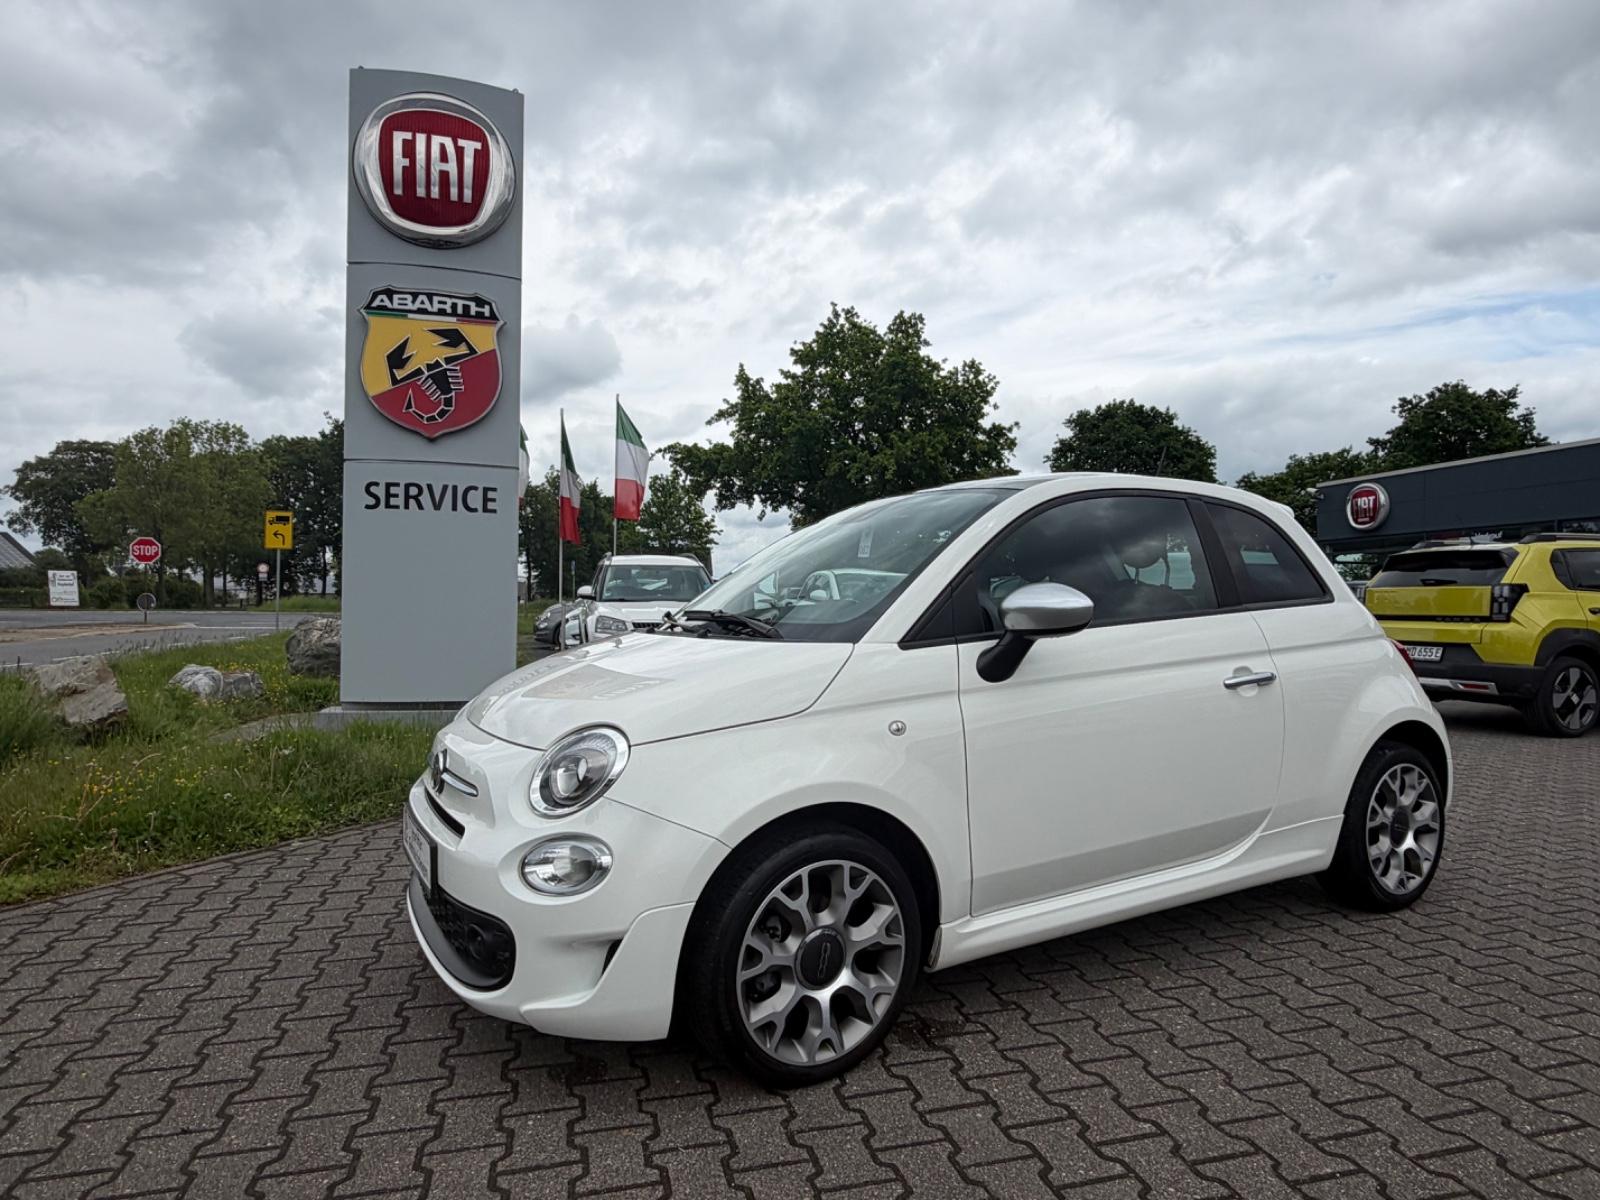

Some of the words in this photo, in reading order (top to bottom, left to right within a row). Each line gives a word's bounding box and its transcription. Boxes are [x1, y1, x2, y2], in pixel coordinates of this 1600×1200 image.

[392, 130, 482, 204] FIAT
[371, 294, 491, 317] ABARTH
[364, 481, 498, 514] SERVICE
[1353, 496, 1376, 518] FIAT
[132, 545, 158, 556] STOP
